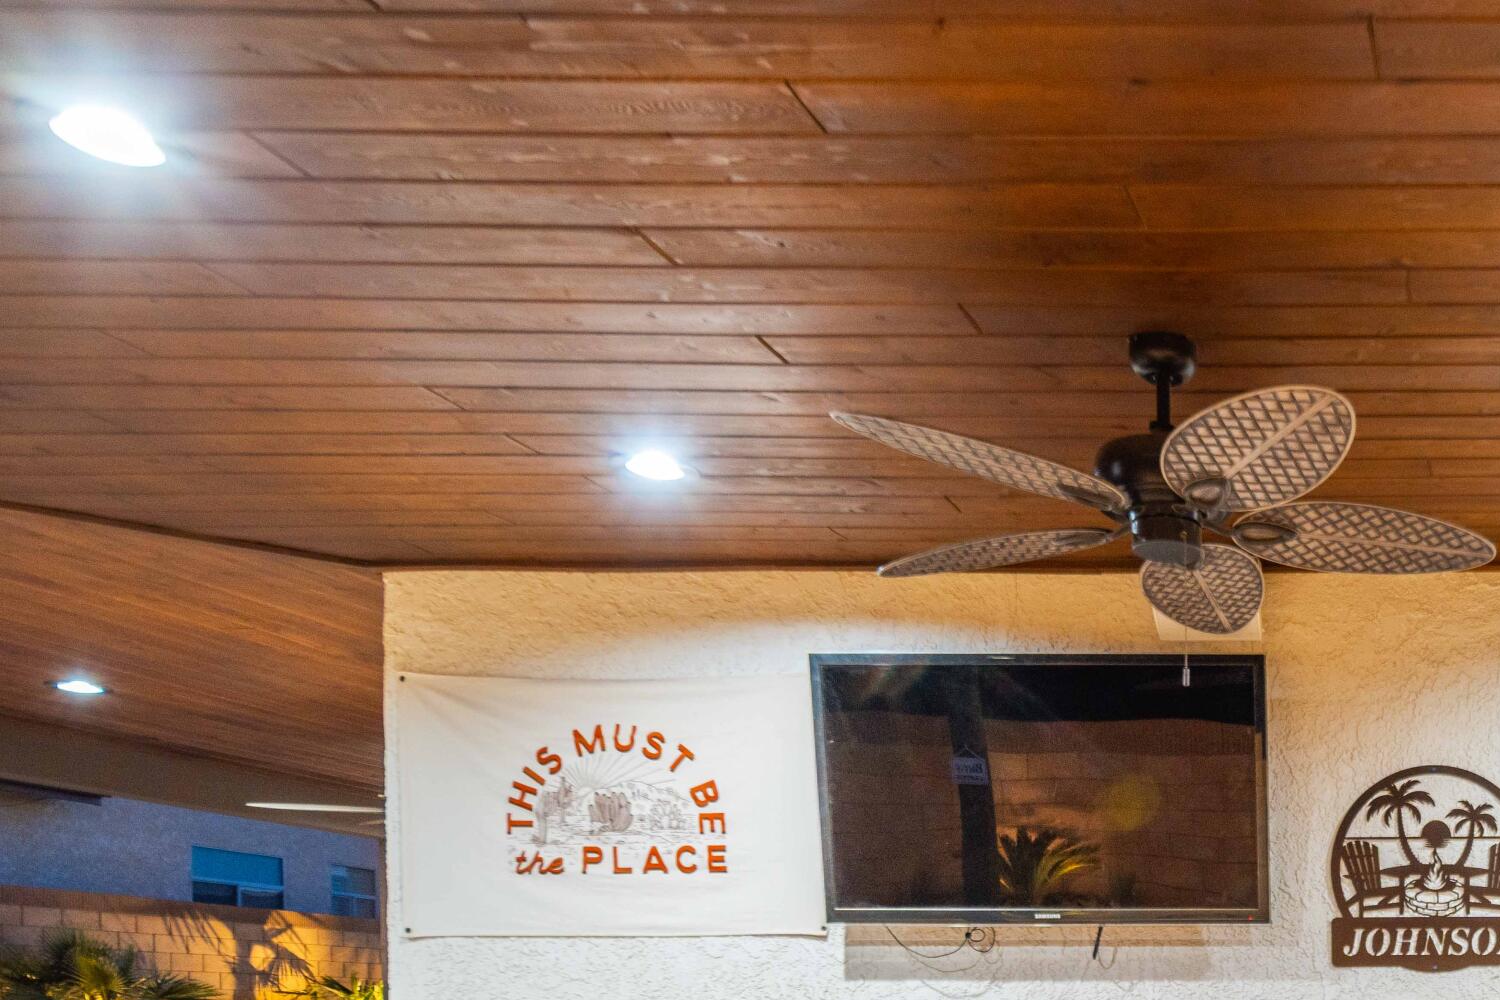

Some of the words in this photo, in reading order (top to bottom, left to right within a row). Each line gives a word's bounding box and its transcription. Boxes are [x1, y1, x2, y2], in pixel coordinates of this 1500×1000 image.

[506, 746, 563, 835] THIS
[572, 724, 695, 772] MUST
[689, 779, 726, 834] BE
[515, 851, 564, 875] the
[582, 844, 728, 875] PLACE
